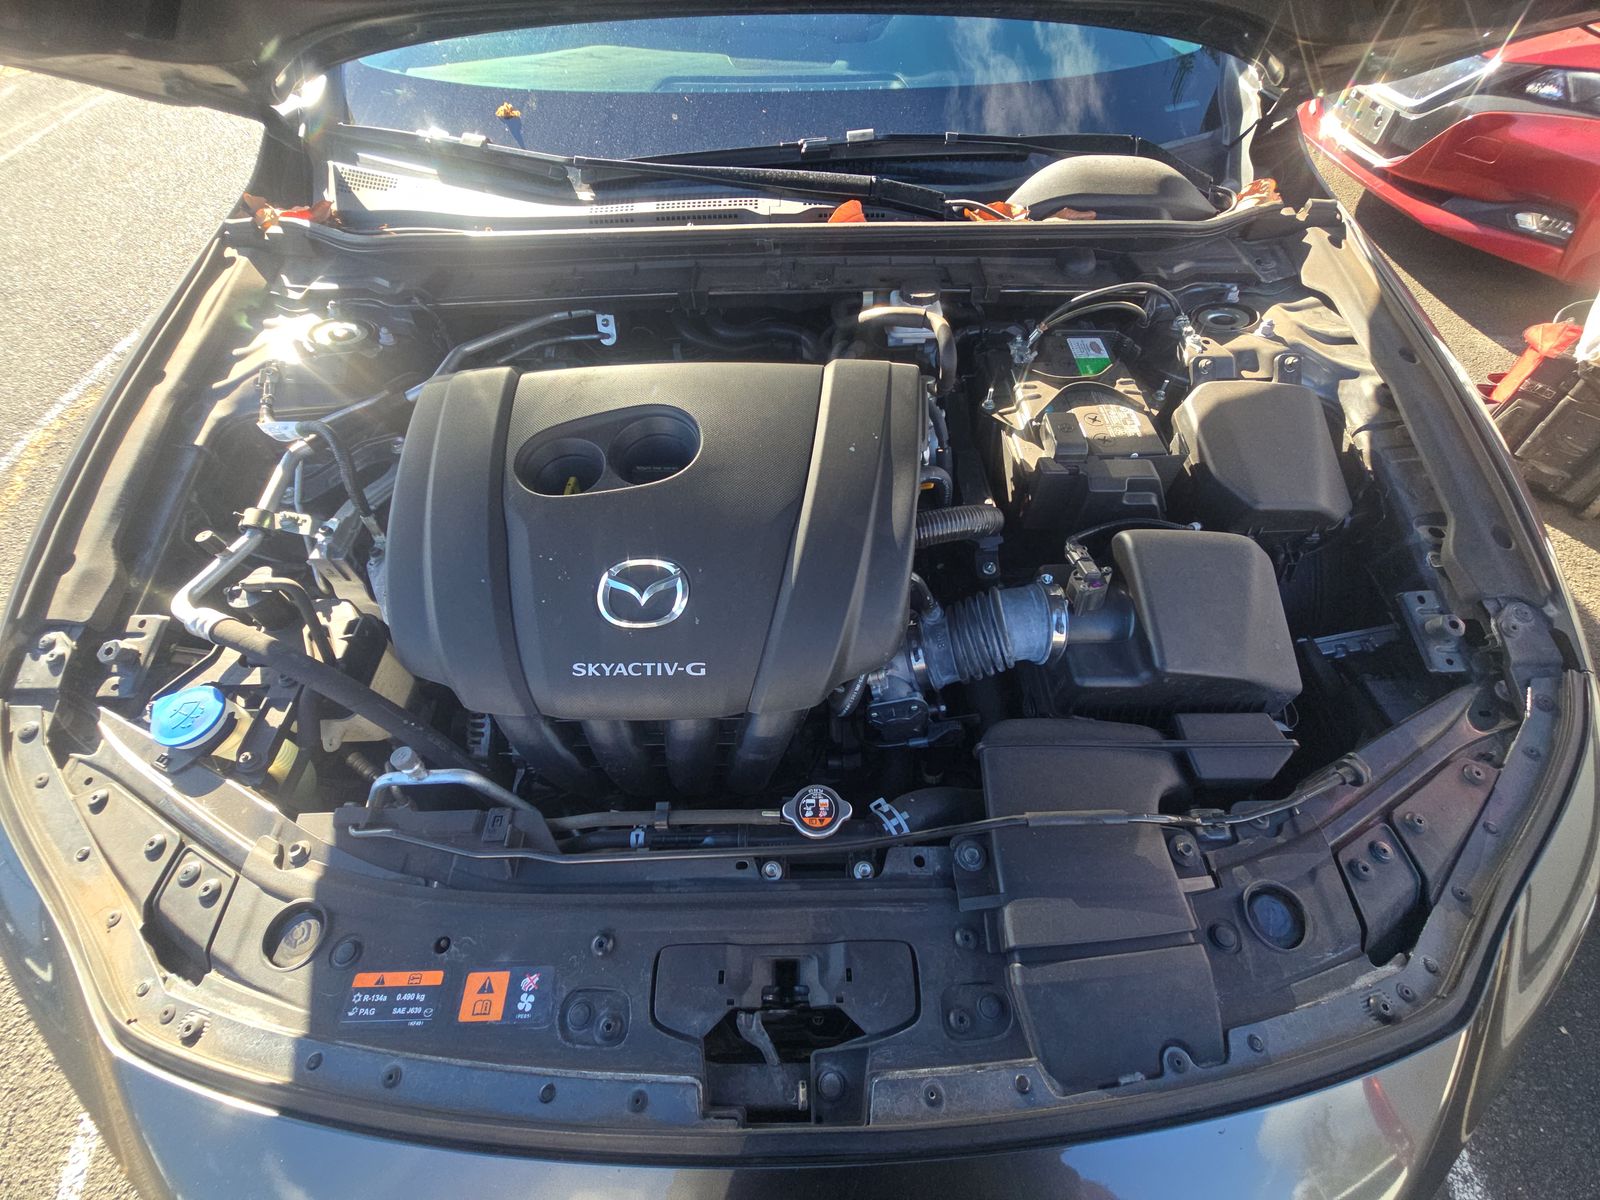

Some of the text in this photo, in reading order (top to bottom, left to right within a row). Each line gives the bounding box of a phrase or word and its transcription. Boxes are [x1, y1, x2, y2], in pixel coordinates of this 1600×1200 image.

[571, 661, 707, 677] SKYACTIV-G
[362, 994, 388, 1002] R-134a
[416, 992, 426, 1002] kg
[358, 1006, 422, 1016] PAG SAE J639
